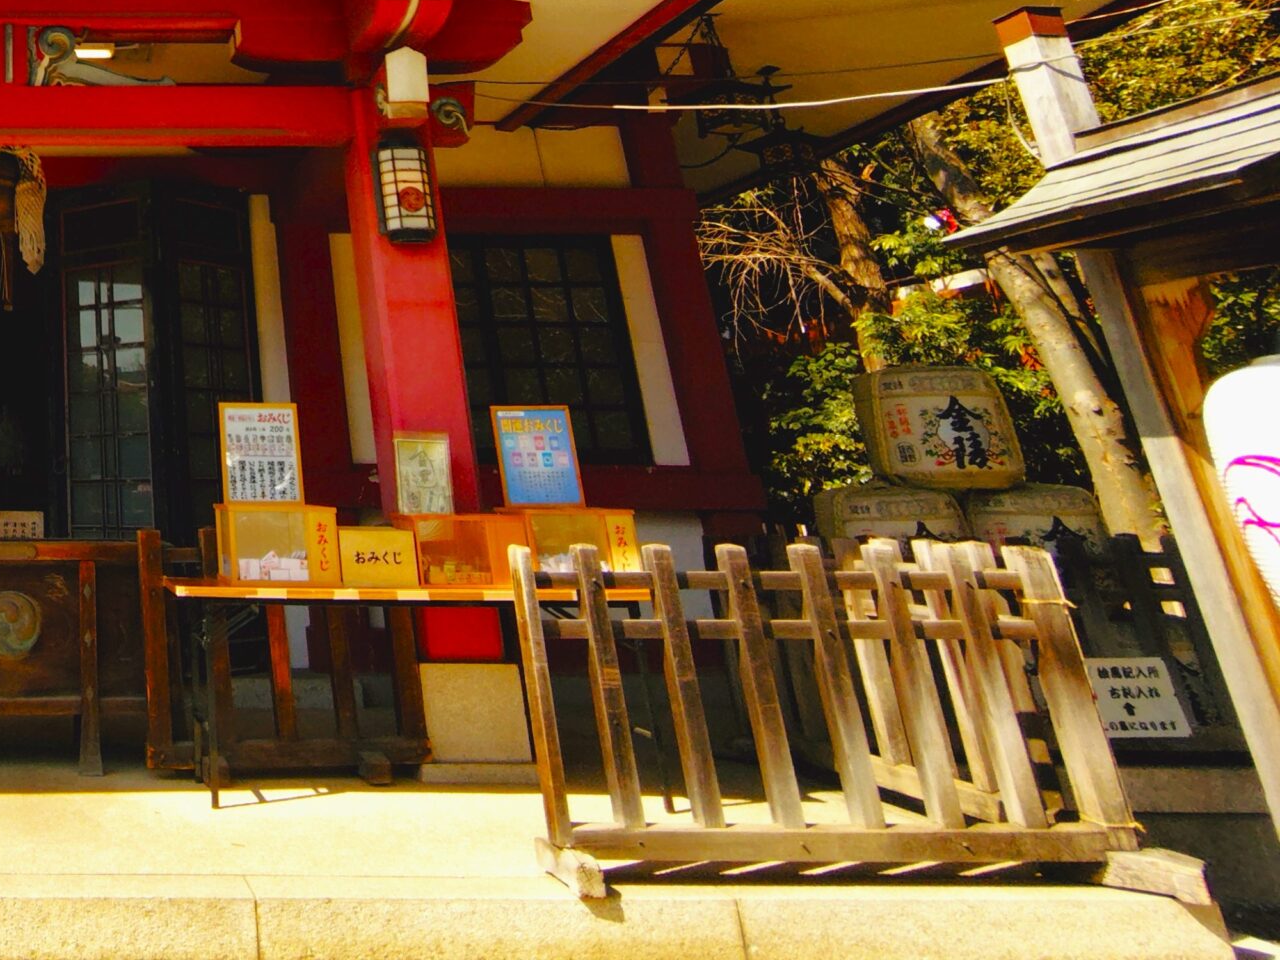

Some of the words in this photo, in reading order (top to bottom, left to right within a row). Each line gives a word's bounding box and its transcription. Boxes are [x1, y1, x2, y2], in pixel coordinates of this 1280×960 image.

[257, 412, 290, 425] おみくじ
[316, 522, 329, 572] おみくじ
[355, 550, 402, 564] おみくじ
